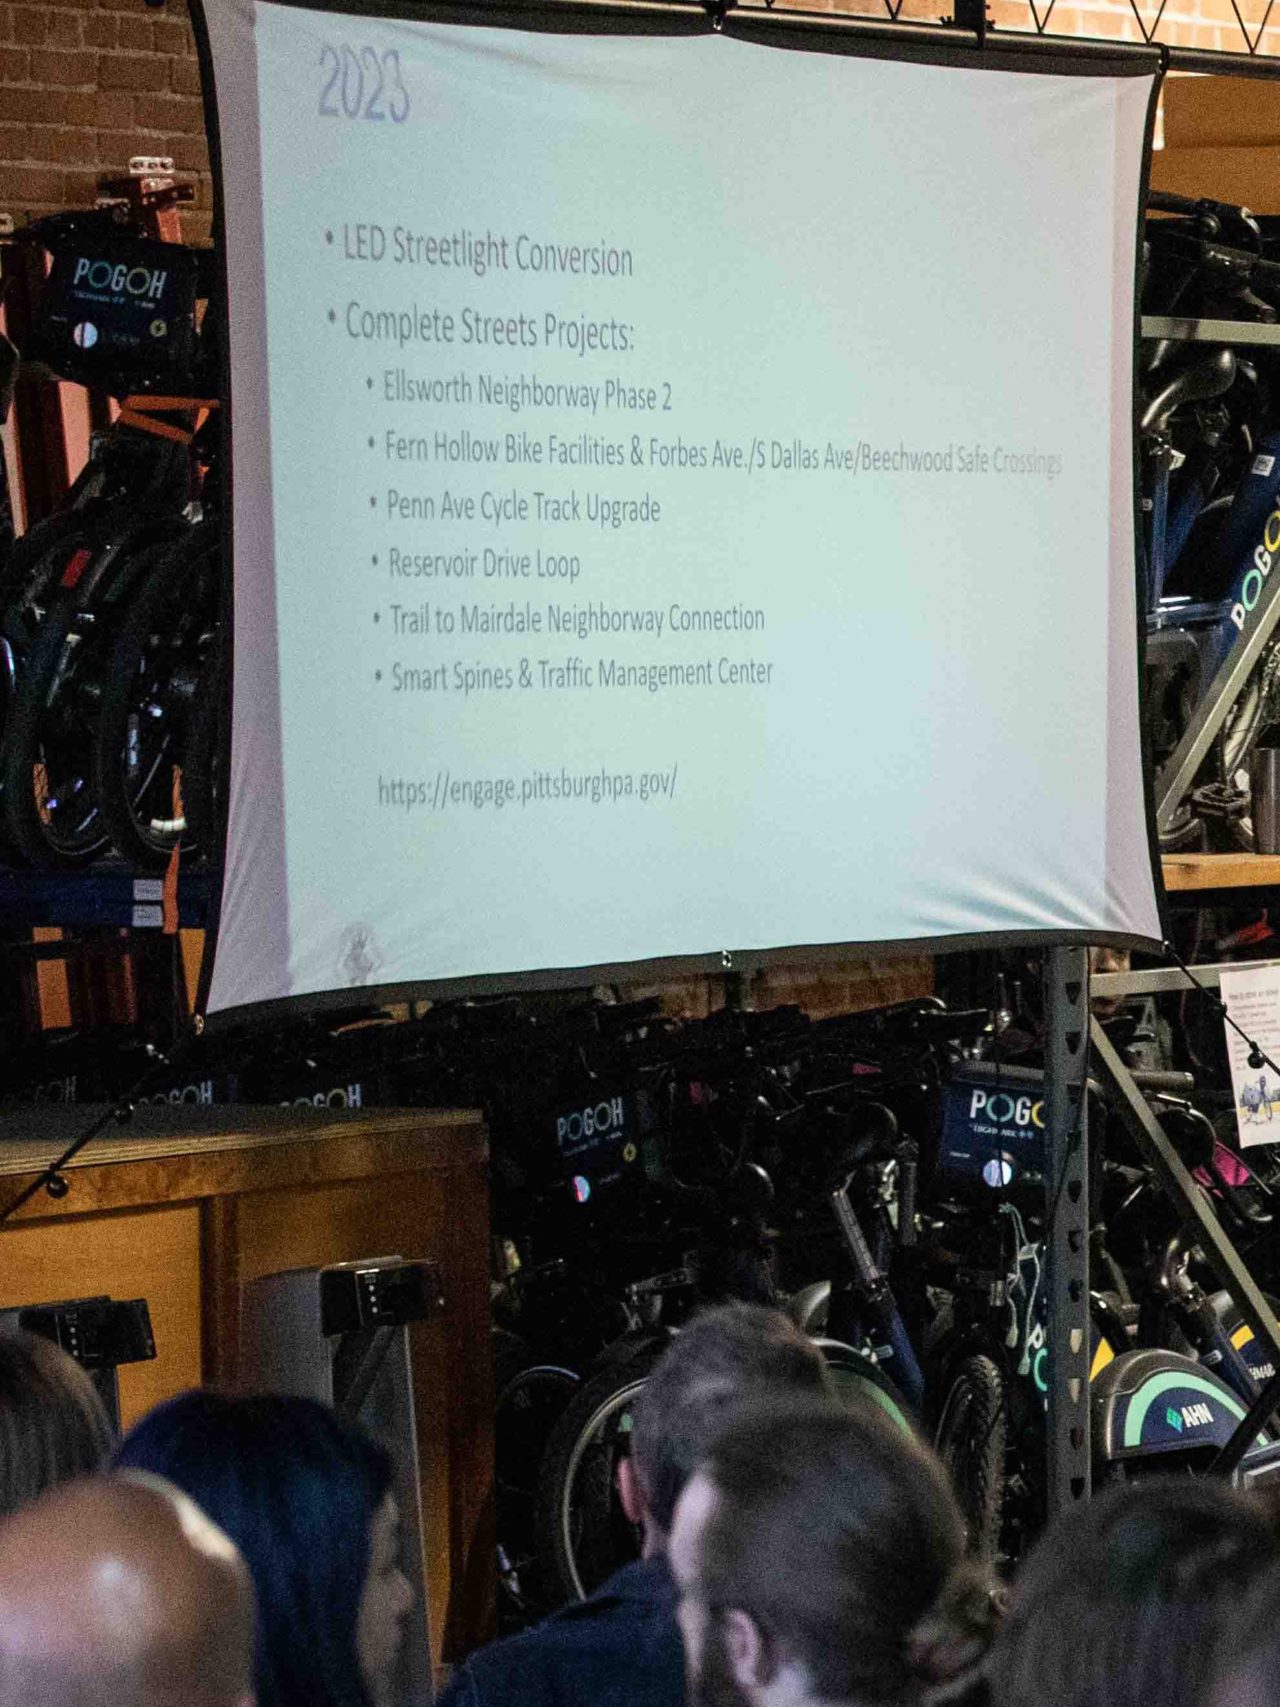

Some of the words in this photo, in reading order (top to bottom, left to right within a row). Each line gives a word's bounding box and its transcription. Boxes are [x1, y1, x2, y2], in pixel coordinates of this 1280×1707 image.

[317, 43, 411, 124] 2023
[343, 224, 386, 262] LED
[393, 226, 509, 277] Streetlight
[516, 236, 633, 276] Conversion
[73, 257, 168, 299] POGOH
[346, 301, 454, 347] Complete
[461, 309, 537, 349] Streets
[545, 312, 635, 357] Projects:
[384, 368, 472, 404] Ellsworth
[479, 374, 600, 415] Neighborway
[605, 379, 657, 410] Phase
[663, 382, 672, 411] 2
[386, 430, 428, 461] Fern
[435, 431, 498, 463] Hollow
[505, 433, 542, 464] Bike
[549, 434, 625, 466] Facilities
[630, 434, 644, 466] &
[650, 436, 707, 467] Forbes
[771, 439, 819, 470] Dallas
[824, 440, 953, 476] Ave/Beechwood
[957, 444, 989, 473] Safe
[993, 447, 1063, 480] Crossings
[388, 489, 435, 521] Penn
[441, 490, 475, 520] Ave
[481, 491, 528, 527] Cycle
[534, 490, 581, 521] Track
[587, 492, 661, 529] Upgrade
[390, 547, 477, 577] Reservoir
[484, 548, 531, 578] Drive
[537, 549, 581, 583] Loop
[390, 603, 430, 634] Trail
[436, 607, 455, 634] to
[461, 601, 542, 634] Mairdale
[548, 603, 664, 639] Neighborway
[669, 603, 765, 633] Connection
[392, 662, 447, 692] Smart
[454, 661, 513, 696] Spines
[518, 658, 533, 688] &
[538, 657, 593, 688] Traffic
[599, 657, 713, 693] Management
[718, 657, 773, 685] Center
[378, 763, 678, 810] https://engage.pittsburghpa.gov/
[556, 1096, 625, 1146] POGOH
[969, 1089, 1045, 1129] POG
[1181, 1402, 1214, 1428] AHN
